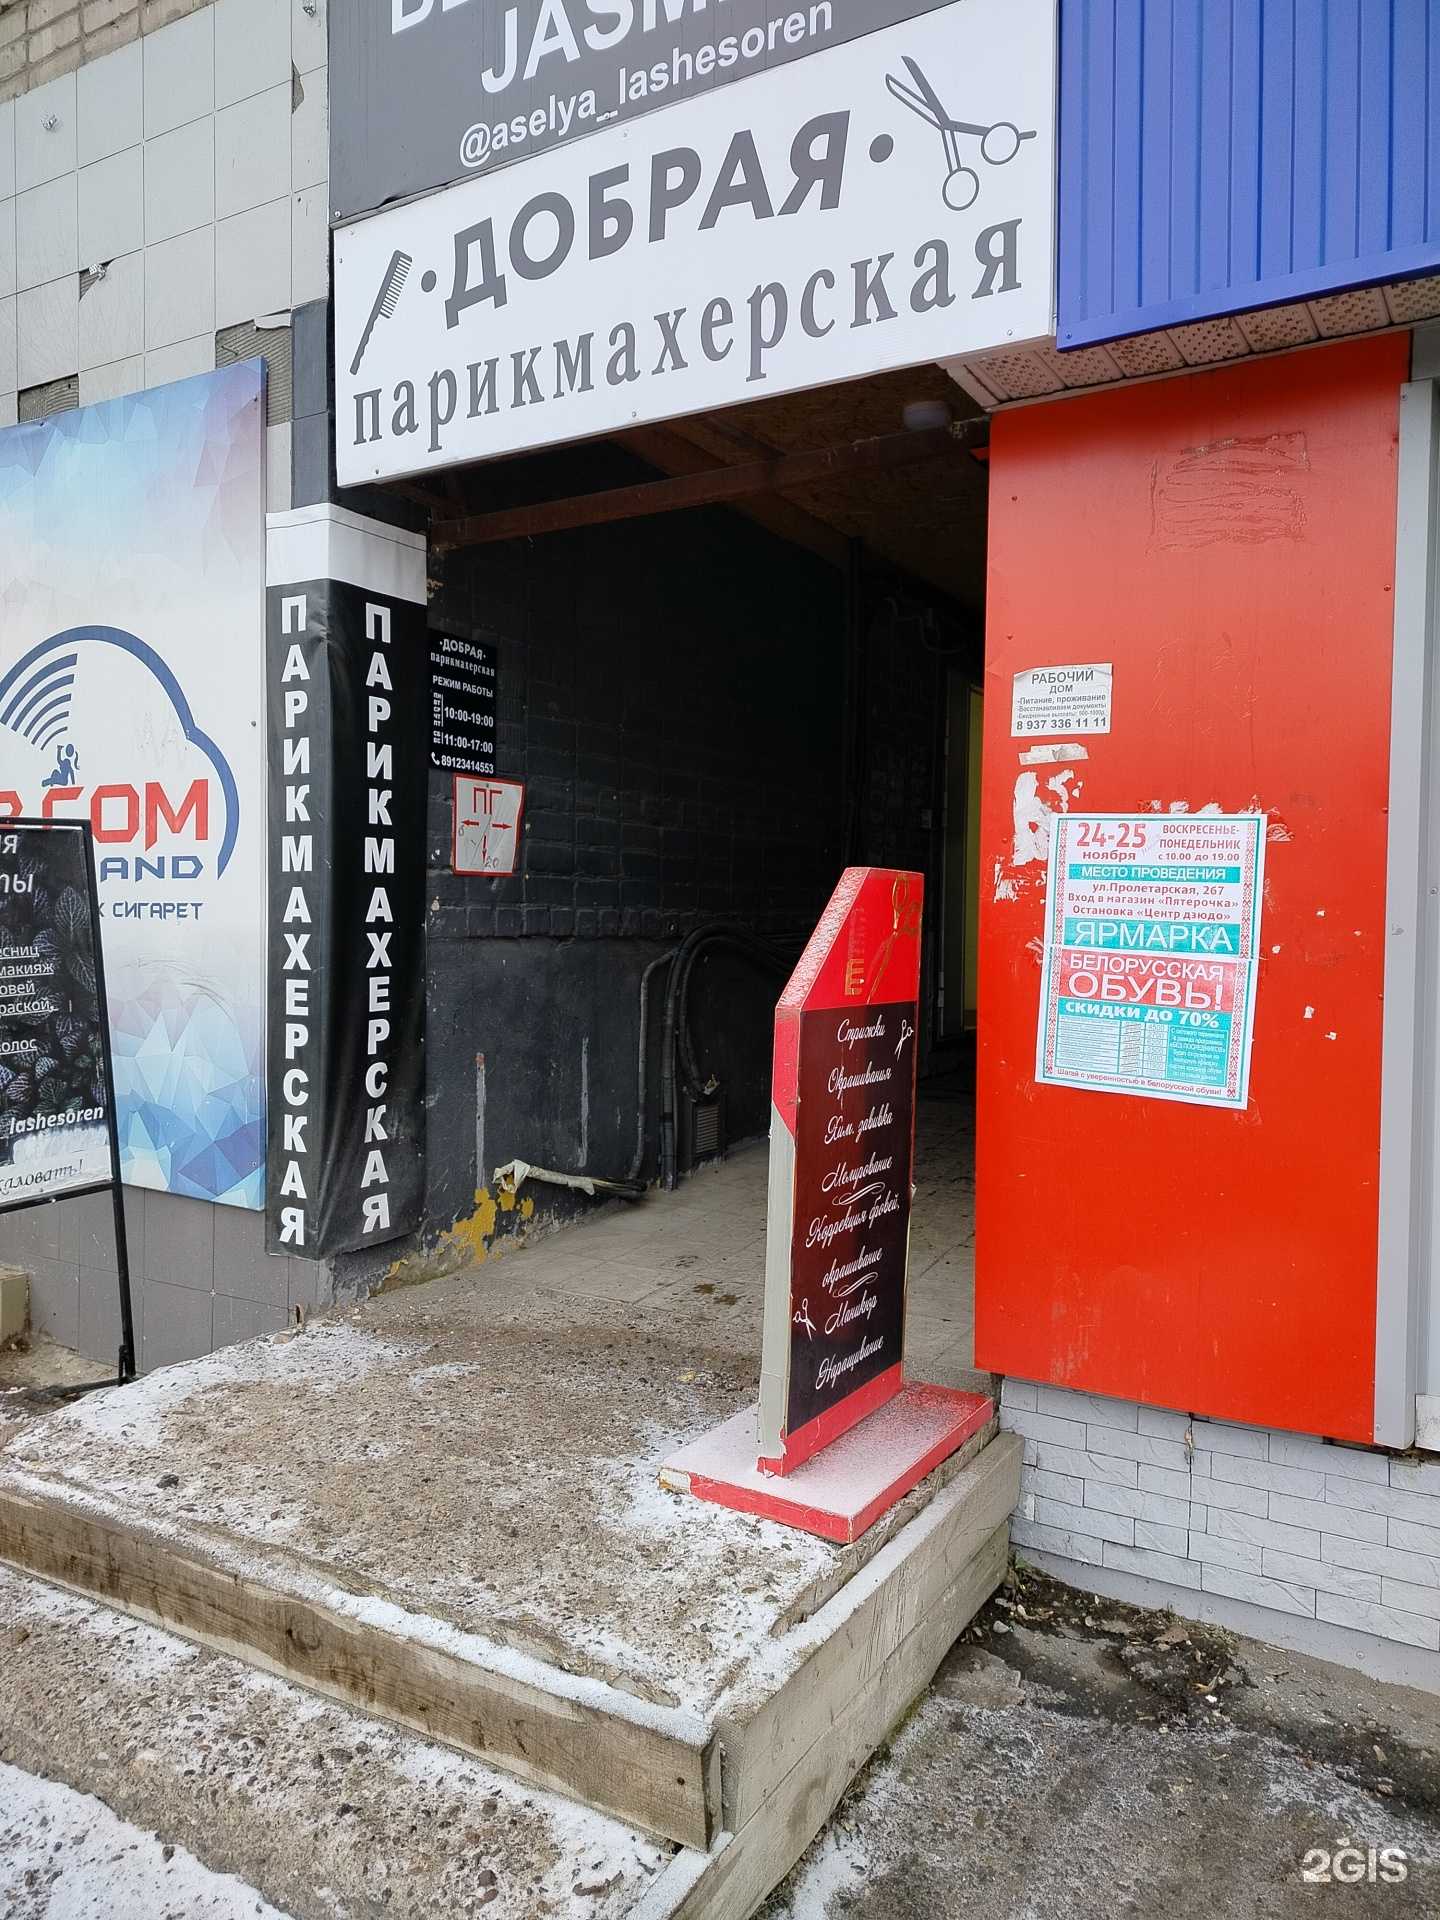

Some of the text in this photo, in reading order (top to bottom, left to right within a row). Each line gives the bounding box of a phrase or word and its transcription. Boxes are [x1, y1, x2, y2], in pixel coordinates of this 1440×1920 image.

[353, 219, 1023, 453] парикмахерская
[430, 651, 495, 677] парикмахерская
[432, 675, 494, 698] РЕЖИМ РАБОТЫ
[1031, 668, 1094, 684] РАБОЧИЙ
[1049, 685, 1073, 694] ДОМ
[1056, 694, 1106, 703] проживание
[444, 706, 494, 727] 10:00-19:00
[1016, 717, 1106, 730] 8 937 336 11 11
[444, 733, 494, 754] 11:00-17:00
[441, 755, 494, 774] 89123414553
[1076, 822, 1147, 849] 24-25
[1159, 839, 1241, 850] ПОНЕДЕЛЬНИК
[1083, 850, 1136, 862] ноября
[1166, 853, 1191, 861] 10.00
[1212, 853, 1240, 861] 19.00
[1081, 866, 1226, 881] МЕСТО ПРОВЕДЕНИЯ
[1068, 893, 1239, 909] Вход в магазин «Пятерочка»
[1203, 886, 1224, 896] 267
[113, 902, 204, 920] СИГАРЕТ
[279, 594, 312, 1246] ПАРИКМАХЕРСКАЯ
[360, 602, 395, 1234] ПАРИКМАХЕРСКАЯ
[1072, 905, 1133, 916] Остановка
[1073, 921, 1233, 951] ЯРМАРКА
[0, 945, 40, 957] сниц
[1070, 953, 1224, 982] БЕЛОРУССКАЯ
[1068, 971, 1223, 1011] ОБУВЬ!
[1179, 1010, 1221, 1029] 70%
[837, 1015, 886, 1050] Стрижки
[0, 1038, 37, 1054] олос
[9, 1106, 104, 1135] lashesoren
[856, 1102, 894, 1143] завивка
[822, 1152, 893, 1192] Мелирование
[806, 1206, 867, 1248] Коррекция
[822, 1245, 883, 1293] окрашивание
[825, 1290, 877, 1335] Маникюр
[815, 1336, 884, 1390] Наращивание
